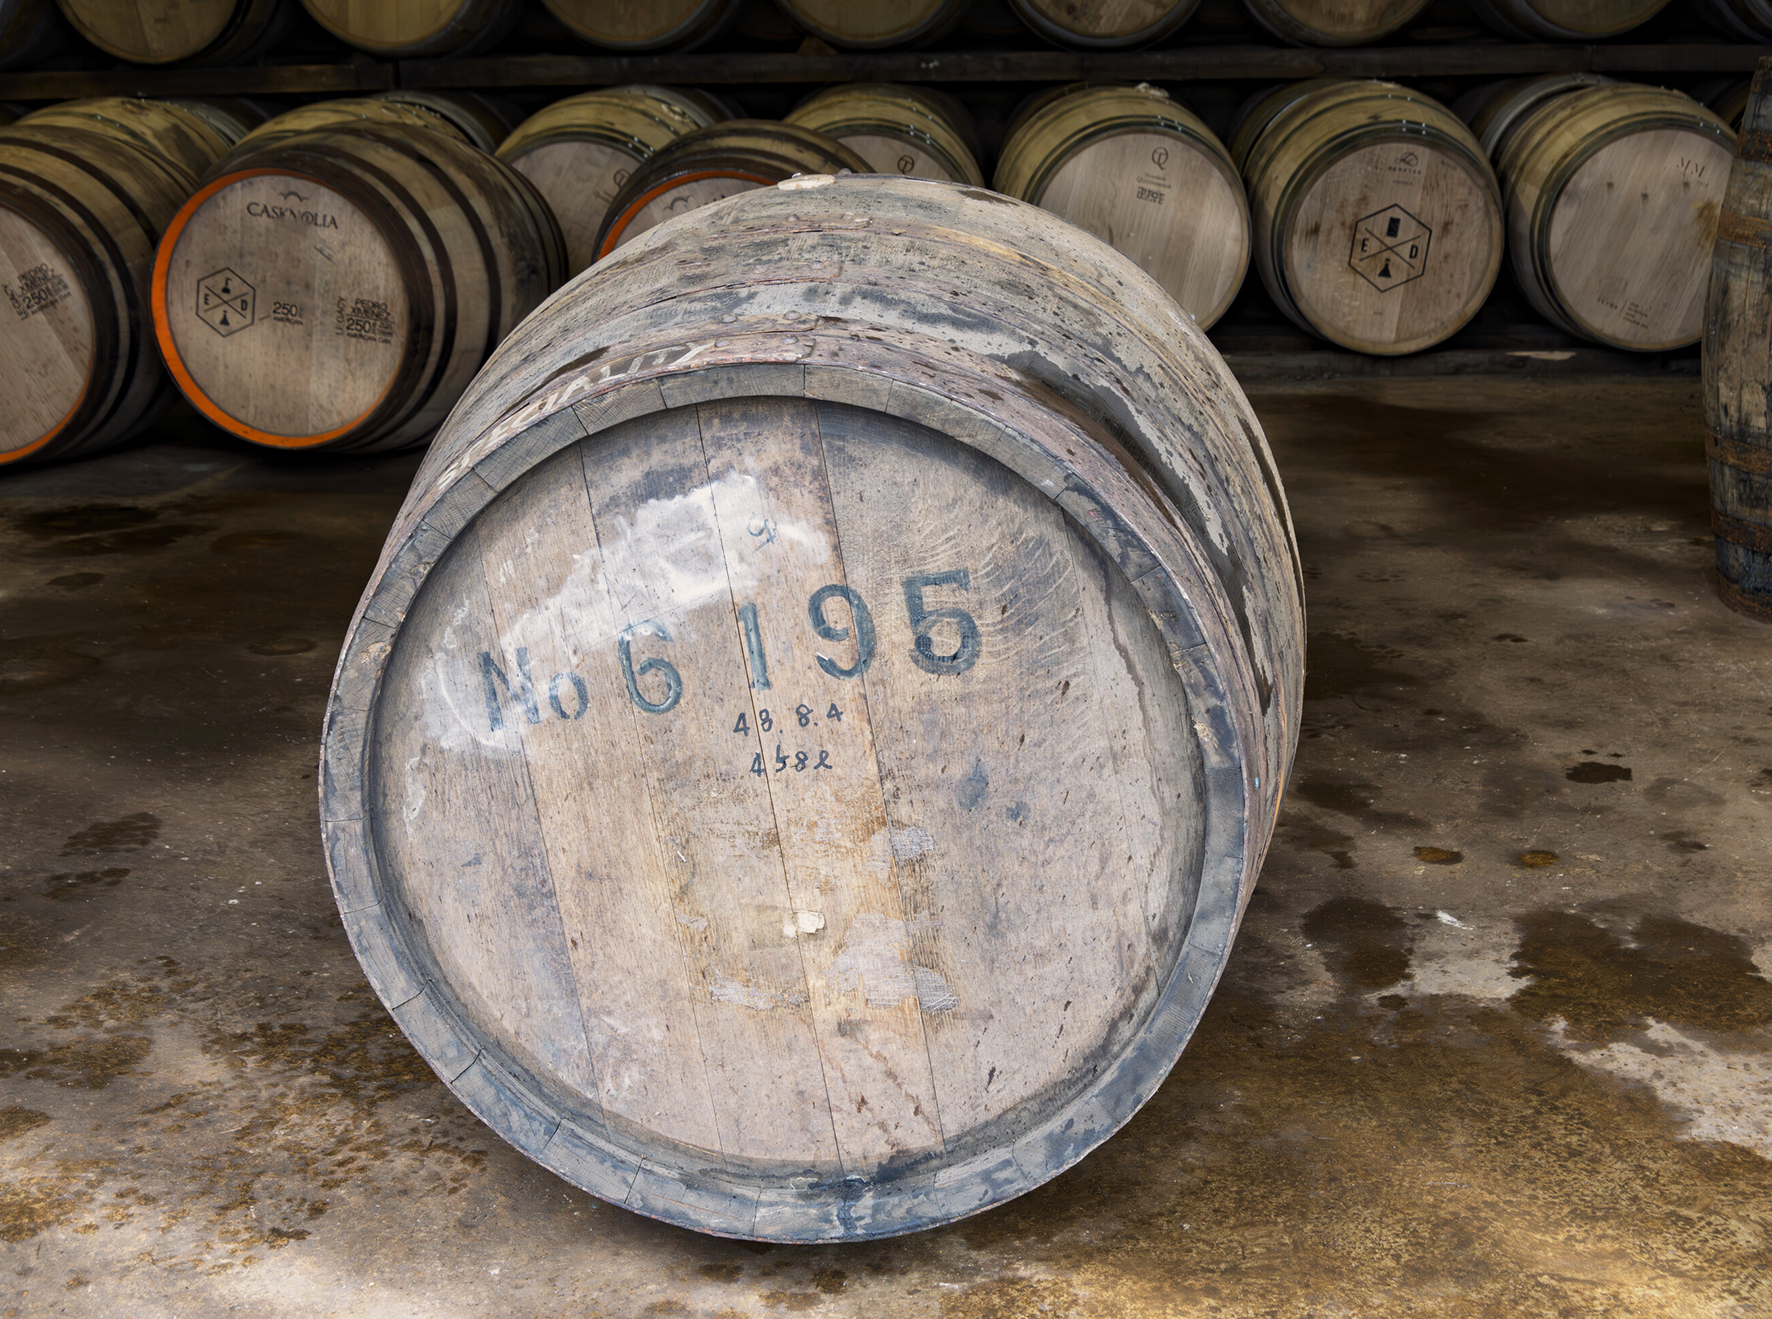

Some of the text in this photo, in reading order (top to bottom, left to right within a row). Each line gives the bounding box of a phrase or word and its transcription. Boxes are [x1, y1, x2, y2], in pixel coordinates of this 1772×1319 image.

[246, 202, 339, 230] CASKNOLIA
[1361, 237, 1419, 259] E D
[22, 288, 49, 310] 250
[204, 293, 248, 311] E D
[272, 301, 298, 317] 250
[346, 317, 372, 334] 250
